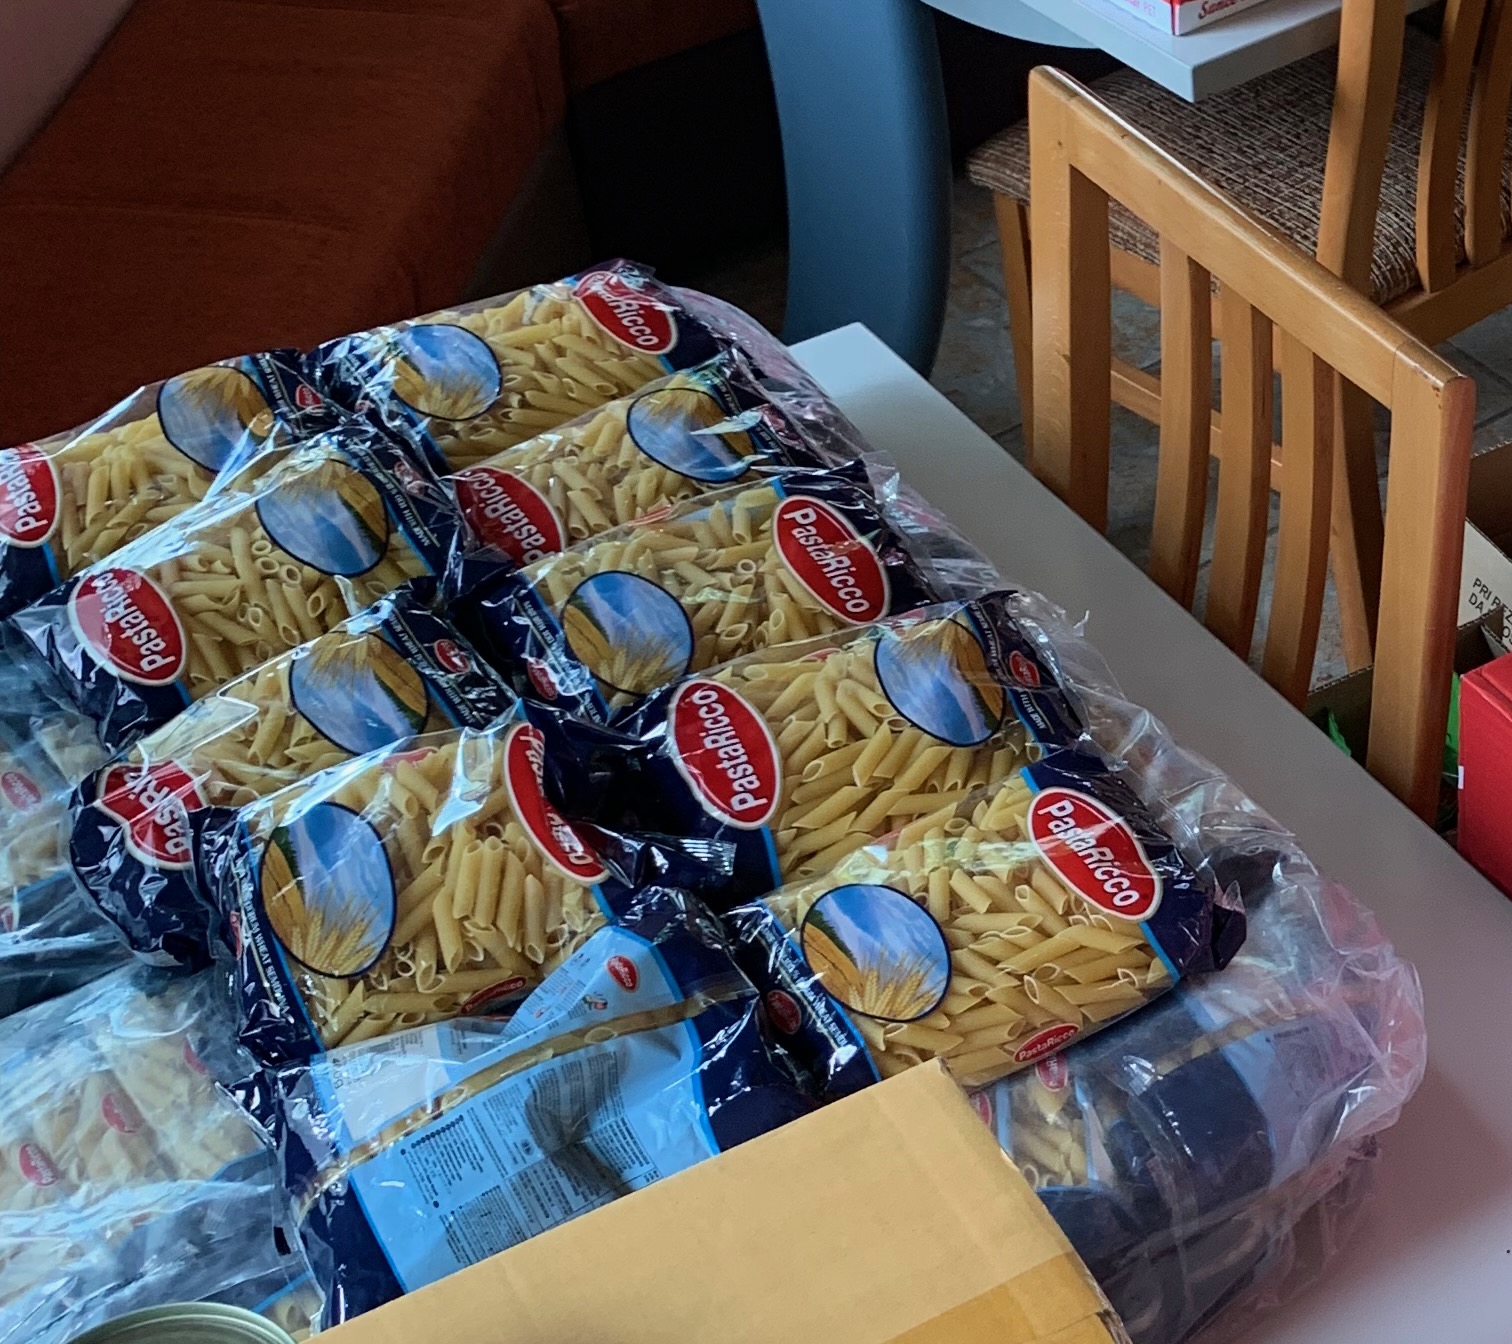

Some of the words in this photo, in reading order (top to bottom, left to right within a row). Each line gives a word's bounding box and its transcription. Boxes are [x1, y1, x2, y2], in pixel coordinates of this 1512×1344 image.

[783, 506, 871, 615] PastaRicco
[1469, 593, 1484, 613] DA
[1473, 578, 1492, 600] PRI
[91, 573, 176, 672] PastaRicco
[693, 689, 767, 812] PastaRicco
[1040, 800, 1141, 908] PastaRicco
[1019, 1031, 1076, 1061] PastaRicco
